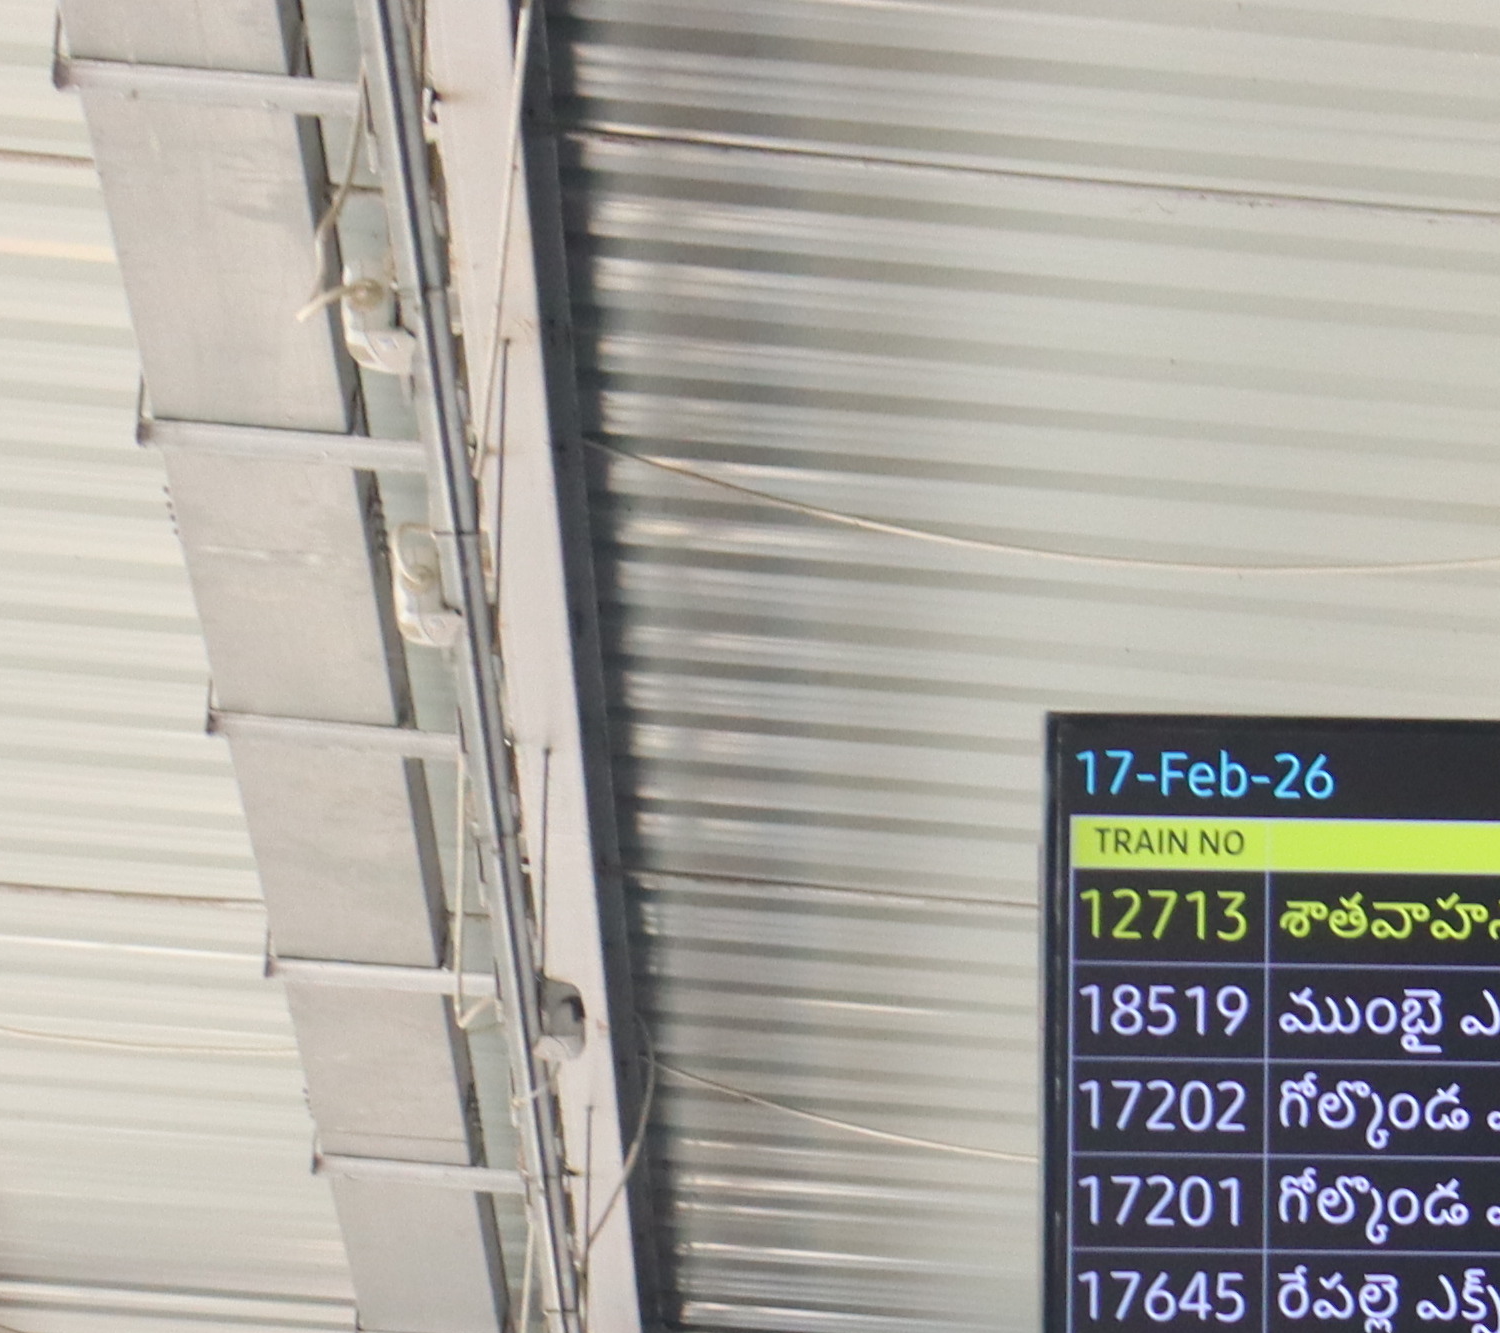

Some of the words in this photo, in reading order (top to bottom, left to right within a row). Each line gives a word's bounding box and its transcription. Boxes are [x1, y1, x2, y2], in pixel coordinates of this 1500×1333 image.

[1077, 750, 1334, 799] 17-Feb-26
[1096, 828, 1187, 854] TRAIN
[1200, 831, 1244, 855] NO
[1081, 889, 1246, 941] 12713
[1080, 984, 1249, 1035] 18519
[1279, 987, 1443, 1053] ముంబై
[1080, 1080, 1245, 1131] 17202
[1280, 1072, 1470, 1149] గోల్కొండ
[1079, 1175, 1240, 1226] 17201
[1279, 1167, 1469, 1244] గోల్కొండ
[1079, 1271, 1245, 1322] 17645
[1279, 1265, 1399, 1333] రేపల్లె
